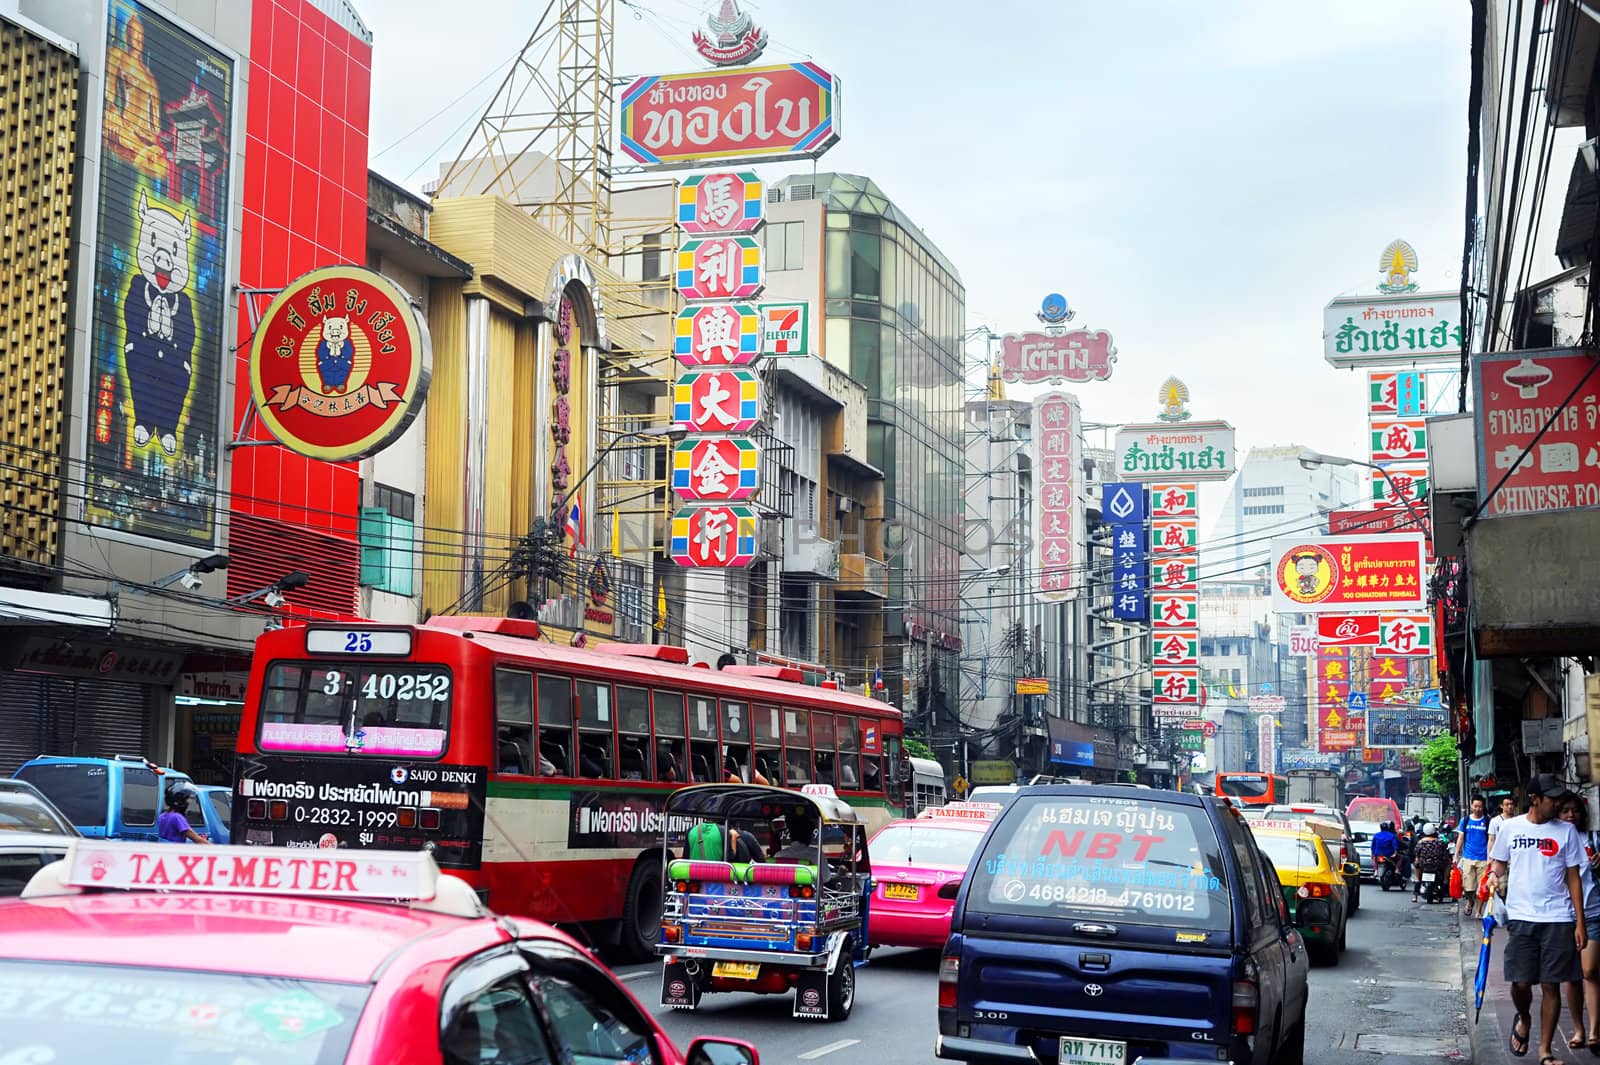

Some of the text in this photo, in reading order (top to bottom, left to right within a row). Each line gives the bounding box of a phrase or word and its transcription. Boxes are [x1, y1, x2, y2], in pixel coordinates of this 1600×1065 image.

[649, 81, 727, 105] ห้างทอง
[642, 76, 812, 149] ทองใบ
[1362, 304, 1434, 321] ห้างขายทอง
[1123, 442, 1226, 472] ฮั่วเซ่งเฮง
[1494, 485, 1571, 514] CHINESE
[344, 632, 373, 652] 25
[1388, 622, 1417, 651] 行
[410, 769, 476, 784] SAIJO DENKI
[254, 780, 419, 806] ฟอกจริง ประหยัดไฟมาก
[805, 786, 829, 795] TAXI
[295, 806, 397, 828] 0-2832-1999
[590, 805, 638, 833] ฟอกจริง
[1040, 830, 1166, 861] NBT
[129, 853, 360, 892] TAXI-METER
[1030, 883, 1195, 912] 4684218 4761012
[1191, 1031, 1214, 1041] GL
[1089, 1042, 1124, 1059] 7113
